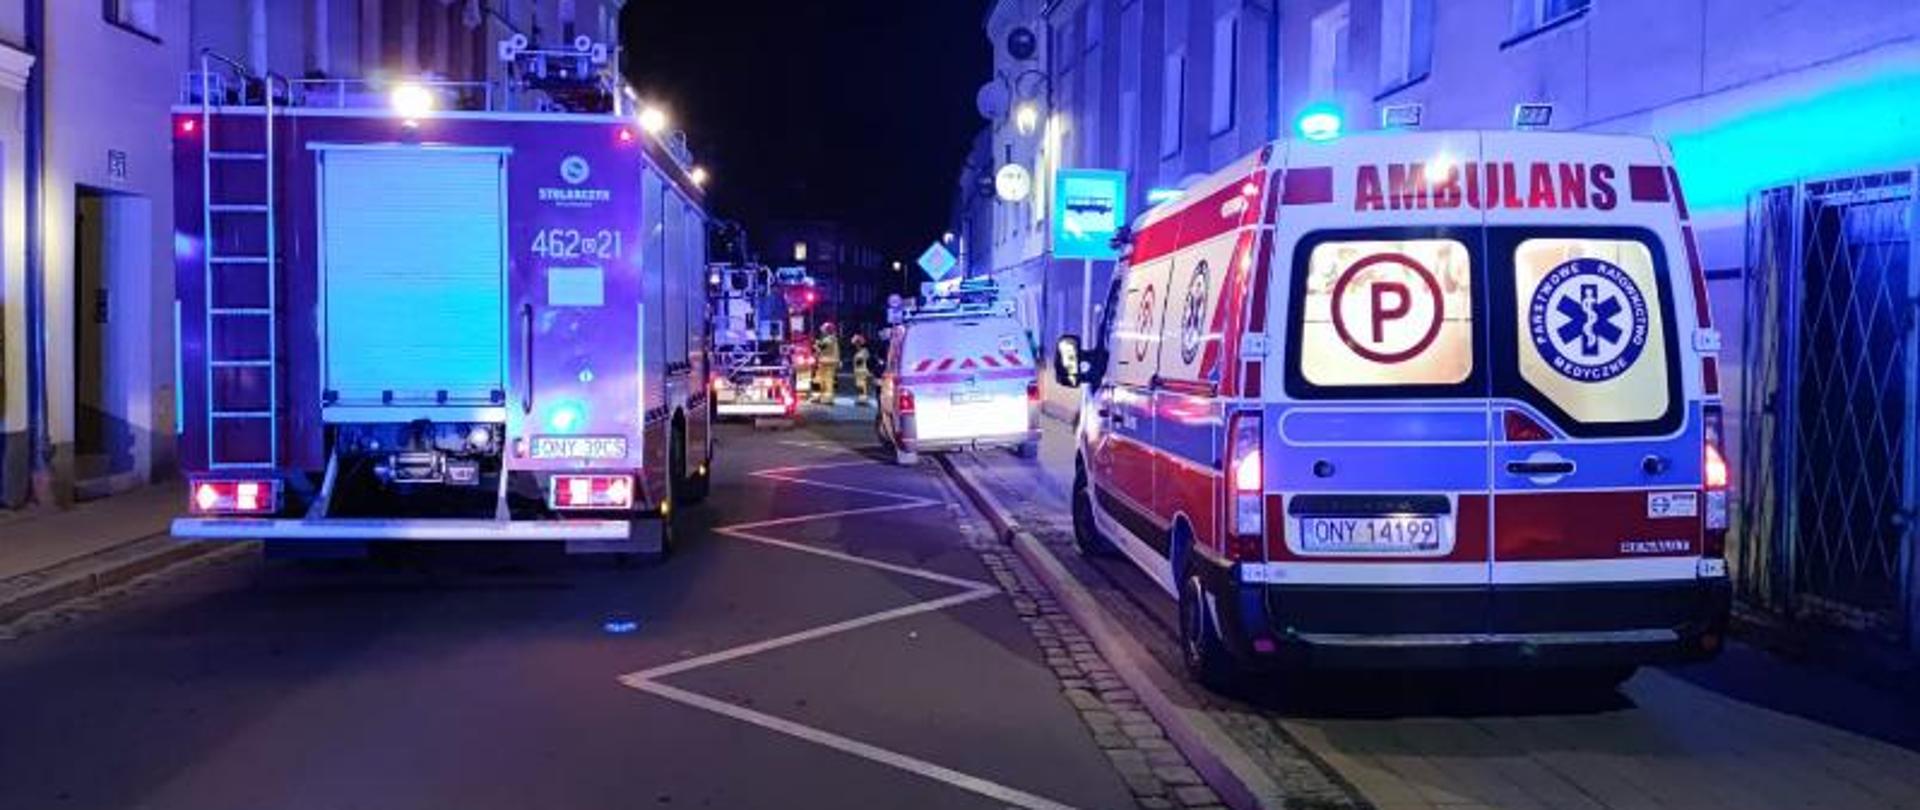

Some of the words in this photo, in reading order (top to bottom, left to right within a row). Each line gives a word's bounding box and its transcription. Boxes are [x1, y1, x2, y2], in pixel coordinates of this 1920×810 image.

[1354, 161, 1618, 211] AMBULANS
[1371, 281, 1411, 343] P
[1552, 356, 1628, 379] MEDYCZNE
[1315, 519, 1357, 543] ONY
[1366, 519, 1433, 544] 14199
